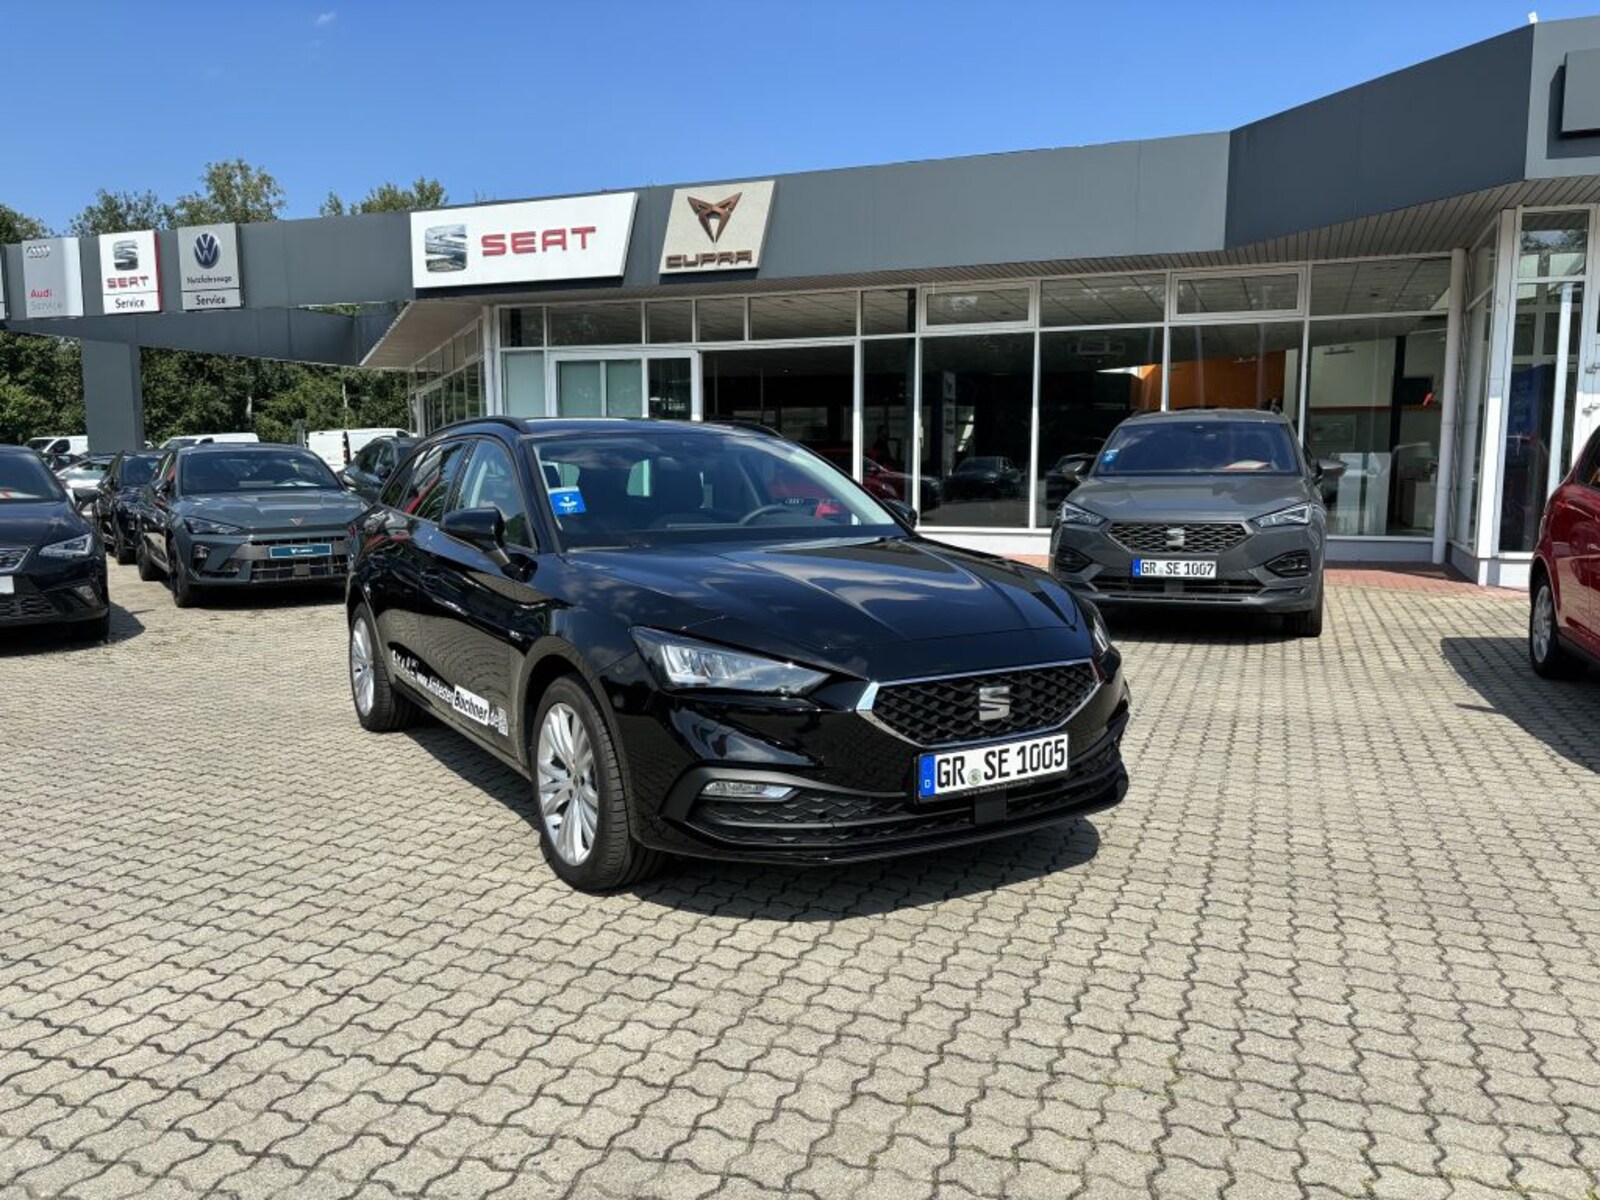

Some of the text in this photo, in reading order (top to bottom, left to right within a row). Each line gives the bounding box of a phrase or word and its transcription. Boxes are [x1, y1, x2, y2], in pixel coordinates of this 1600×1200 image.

[481, 226, 597, 257] SEAT
[665, 250, 753, 269] CUPRA
[106, 275, 149, 289] SEAT
[30, 288, 53, 298] Audi
[115, 297, 145, 309] Service
[196, 295, 226, 306] Service
[1141, 562, 1214, 576] GR SE 1007
[936, 755, 966, 789] GR
[983, 748, 1011, 781] SE
[1016, 738, 1065, 775] 1005
